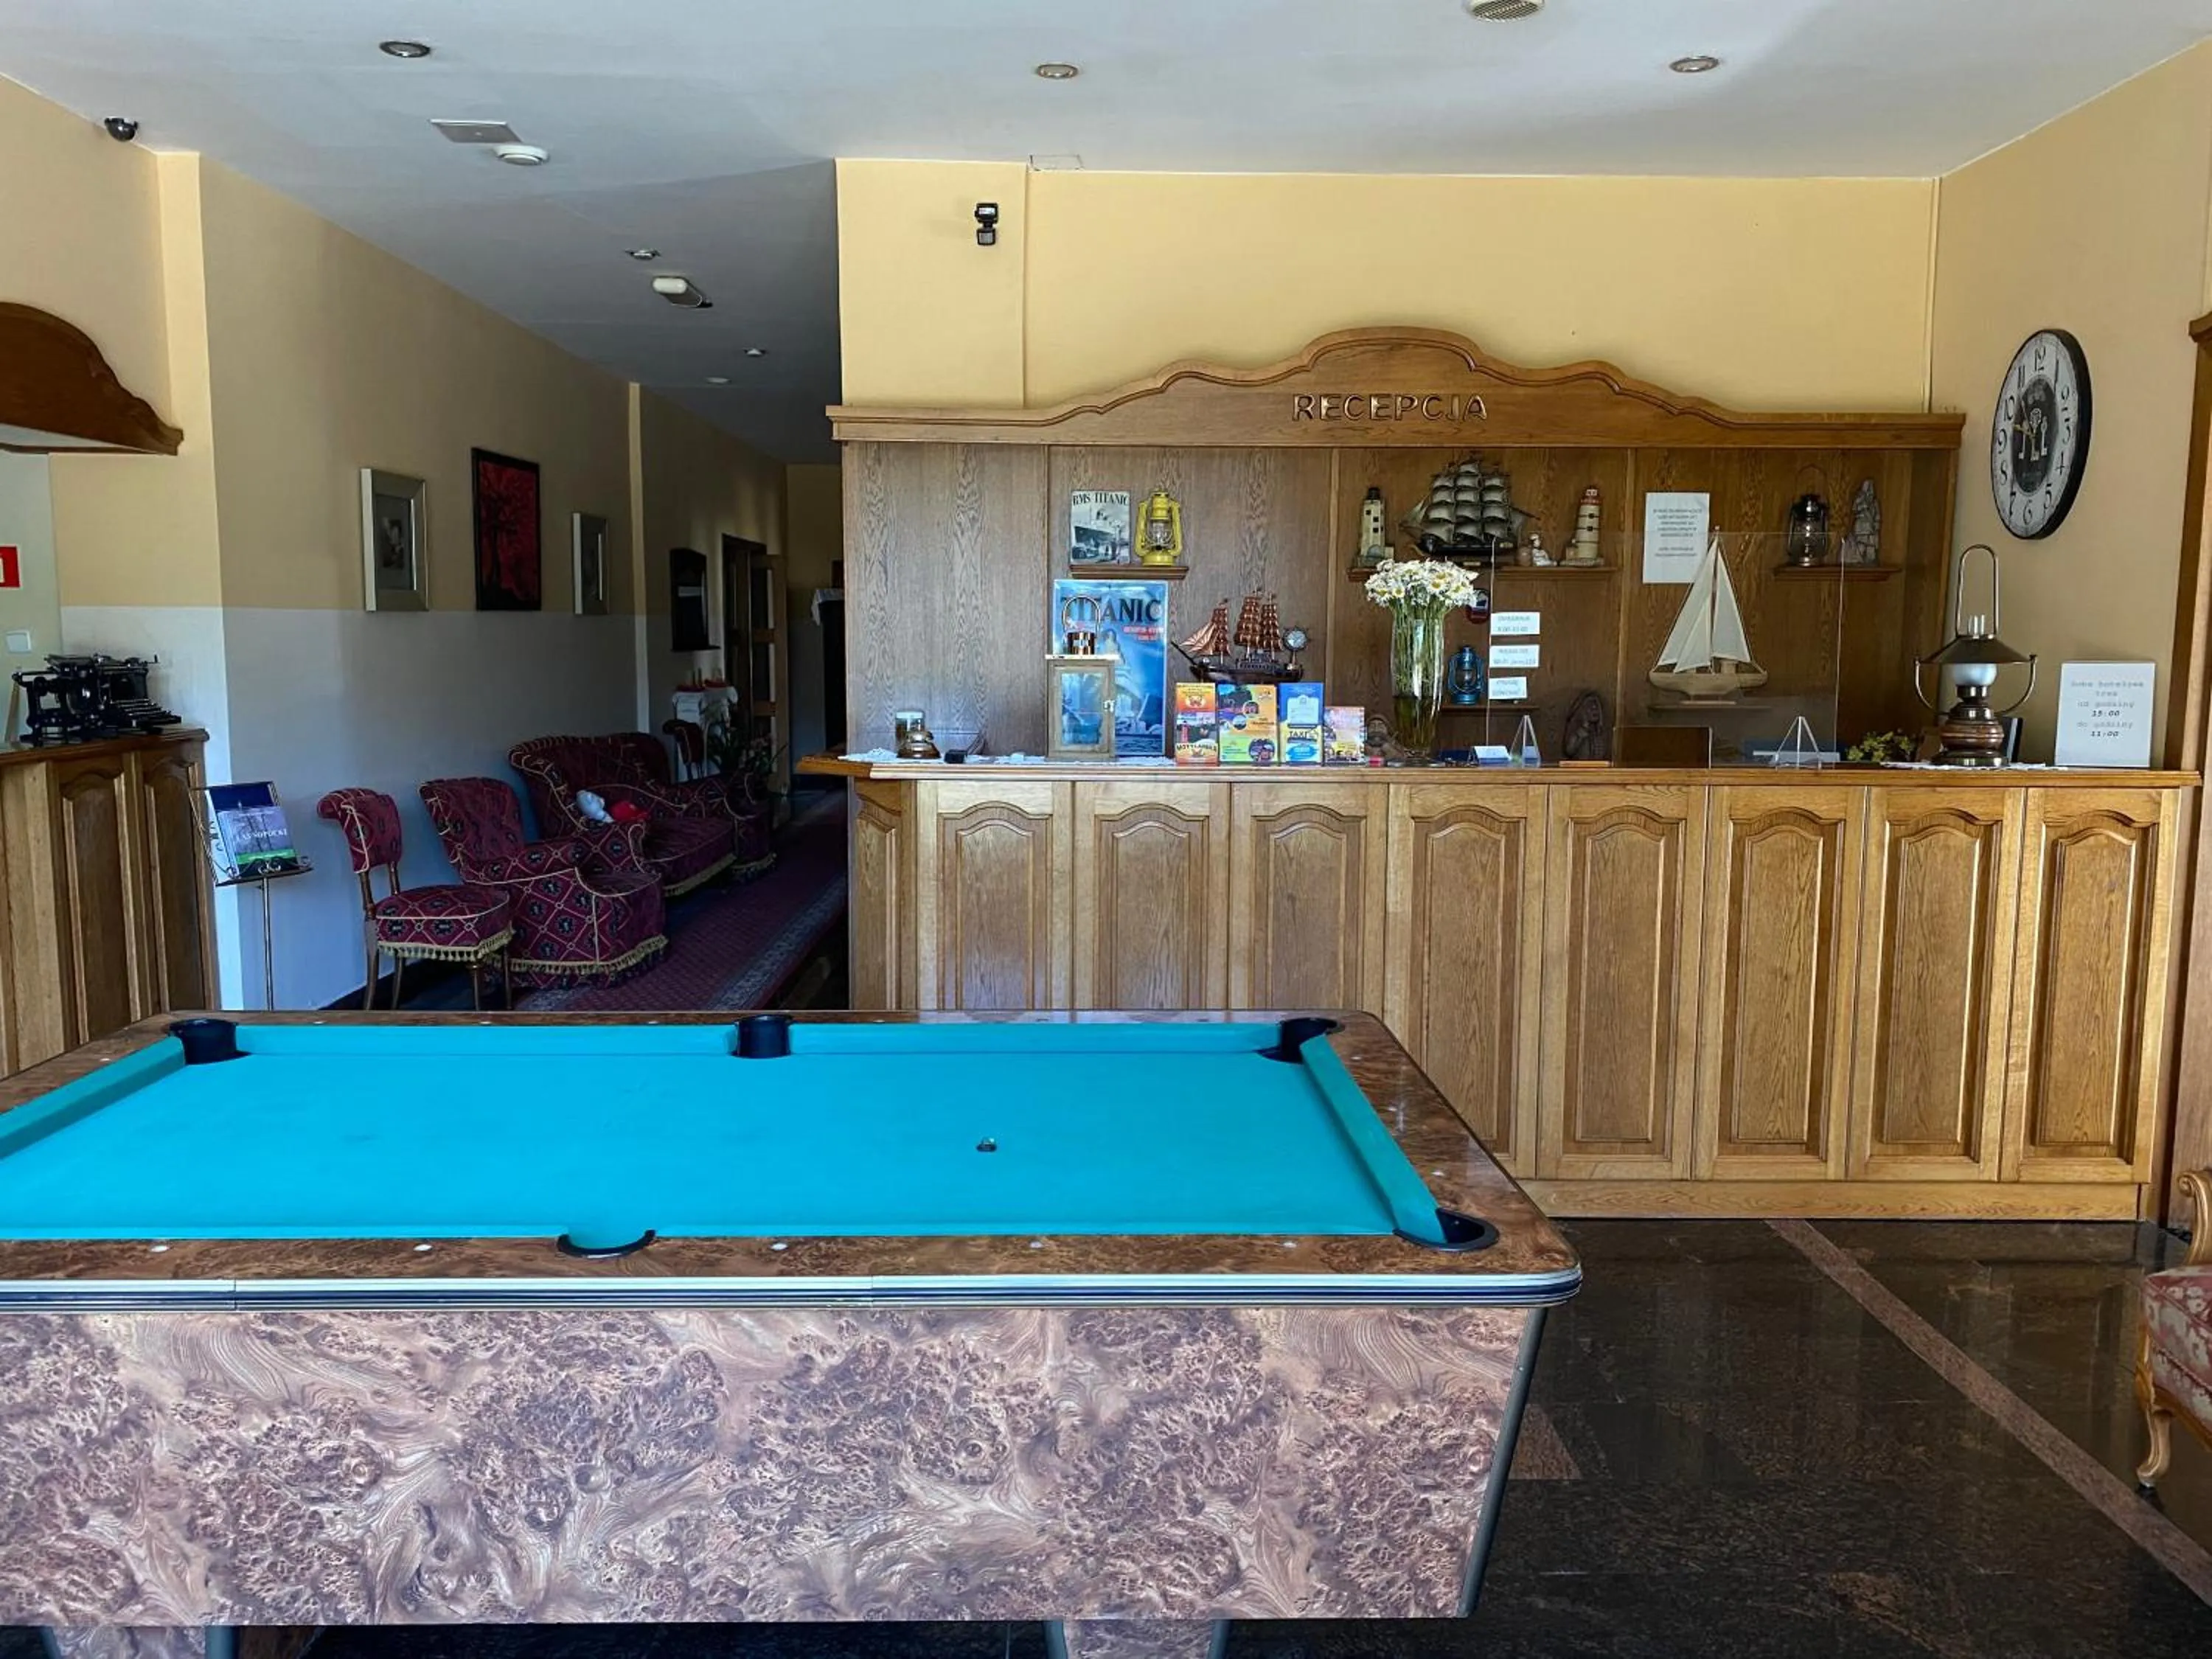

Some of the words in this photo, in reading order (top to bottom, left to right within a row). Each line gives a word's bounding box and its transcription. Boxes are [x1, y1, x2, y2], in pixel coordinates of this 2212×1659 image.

[1292, 394, 1488, 422] RECEPCJA
[2004, 395, 2014, 422] 10
[1997, 428, 2007, 454] 9
[2000, 459, 2007, 485] 8
[2056, 451, 2065, 476] 4
[1073, 493, 1091, 505] RMS
[2008, 491, 2016, 515] 7
[2023, 499, 2033, 525] 6
